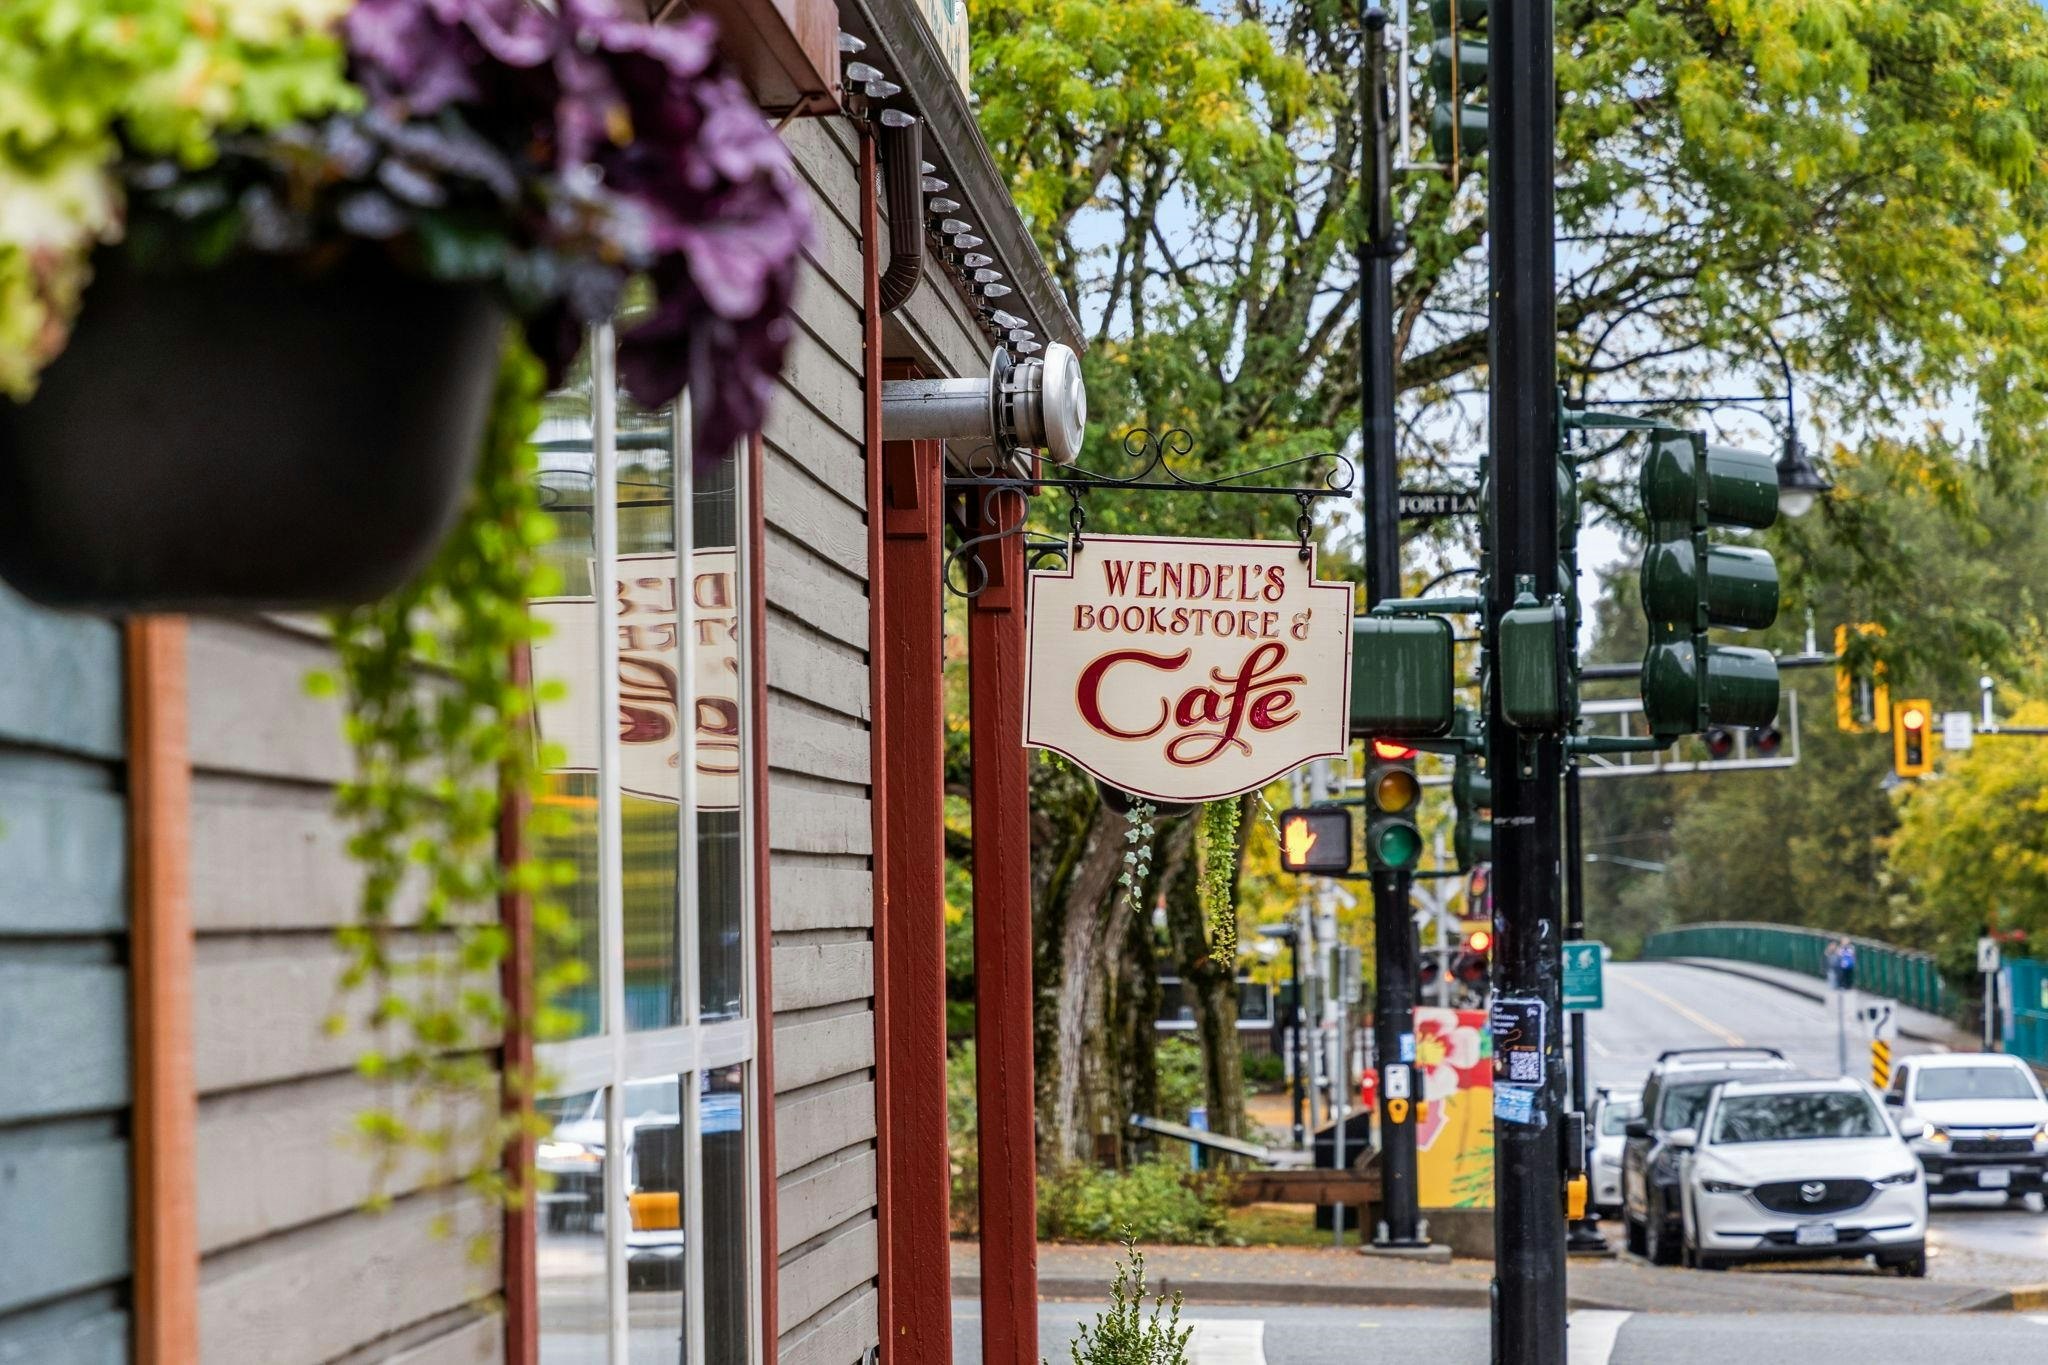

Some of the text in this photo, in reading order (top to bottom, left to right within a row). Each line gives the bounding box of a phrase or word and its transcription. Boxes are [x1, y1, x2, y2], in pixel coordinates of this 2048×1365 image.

[1398, 494, 1480, 514] FORT LA
[1103, 559, 1286, 602] WENDEL'S
[1073, 604, 1313, 641] BOOKSTORE &
[1075, 640, 1308, 768] Cafe
